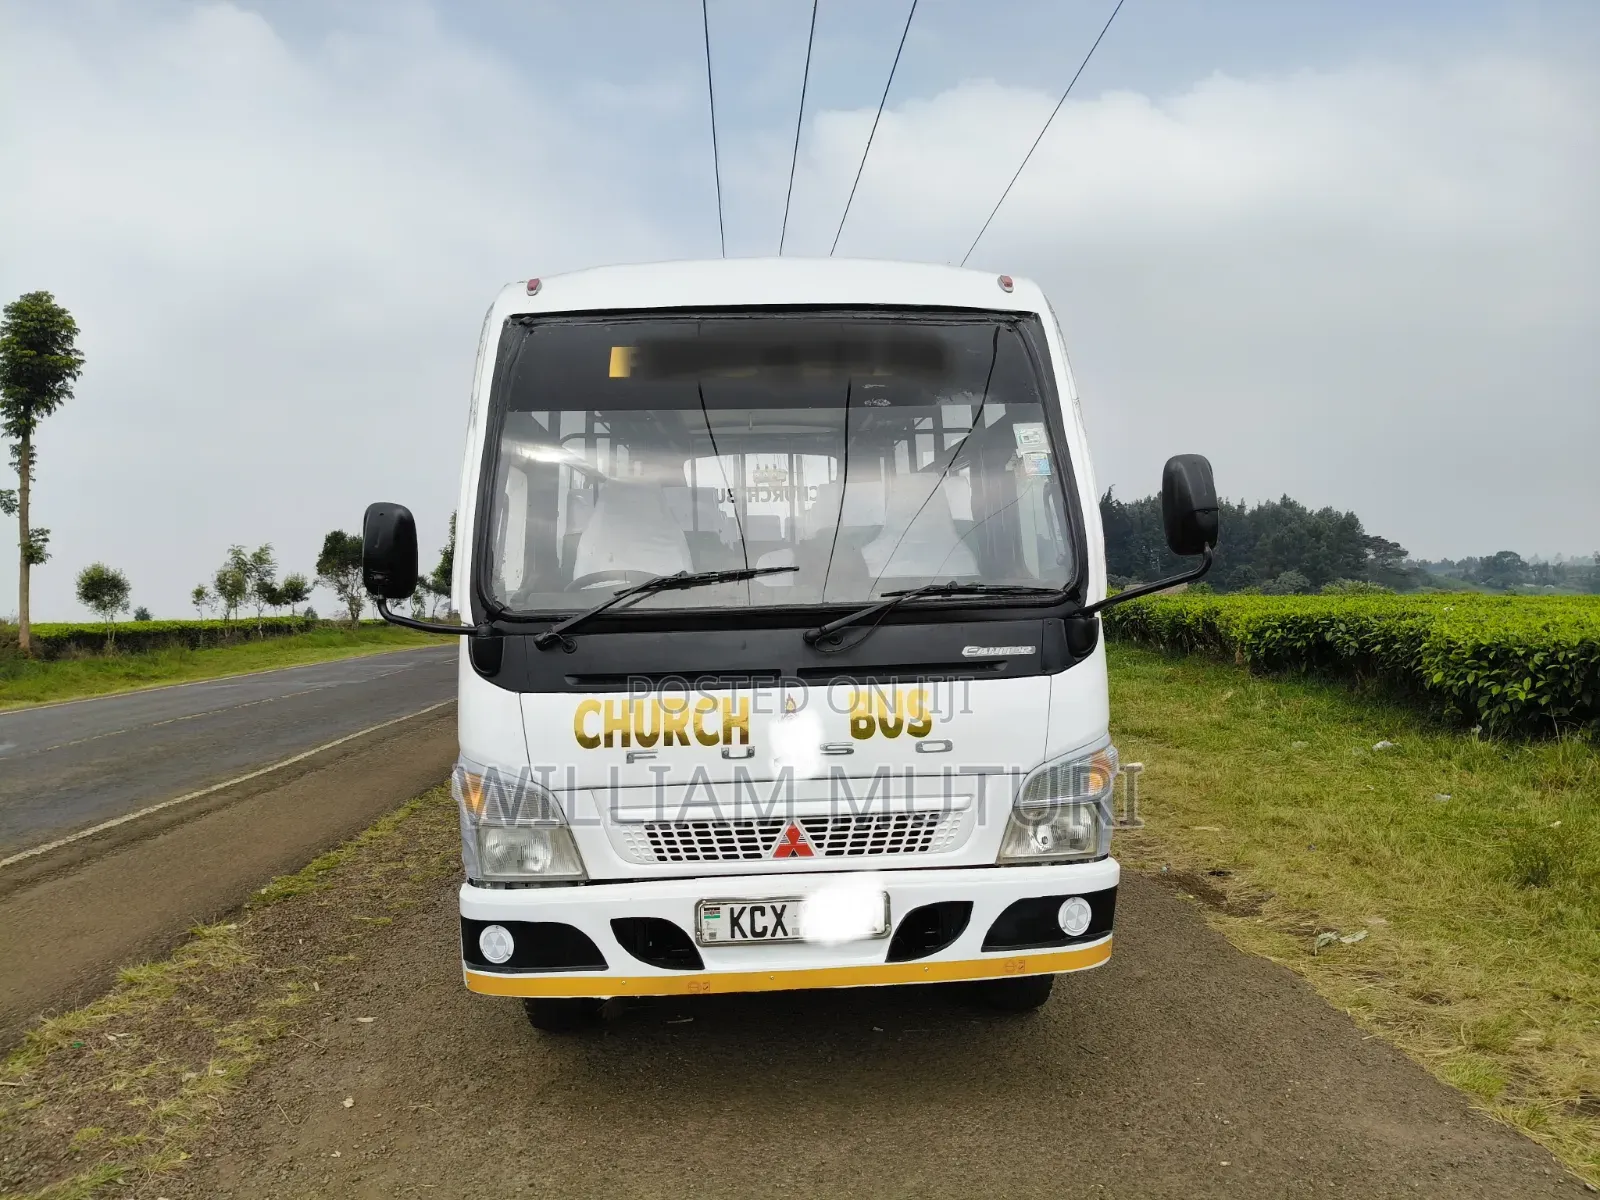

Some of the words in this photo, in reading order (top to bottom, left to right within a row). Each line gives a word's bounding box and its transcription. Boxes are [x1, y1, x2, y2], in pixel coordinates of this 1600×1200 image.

[574, 698, 749, 749] CHURCH
[849, 689, 933, 740] BUS
[626, 739, 953, 763] FUSO
[730, 904, 788, 939] KCX
